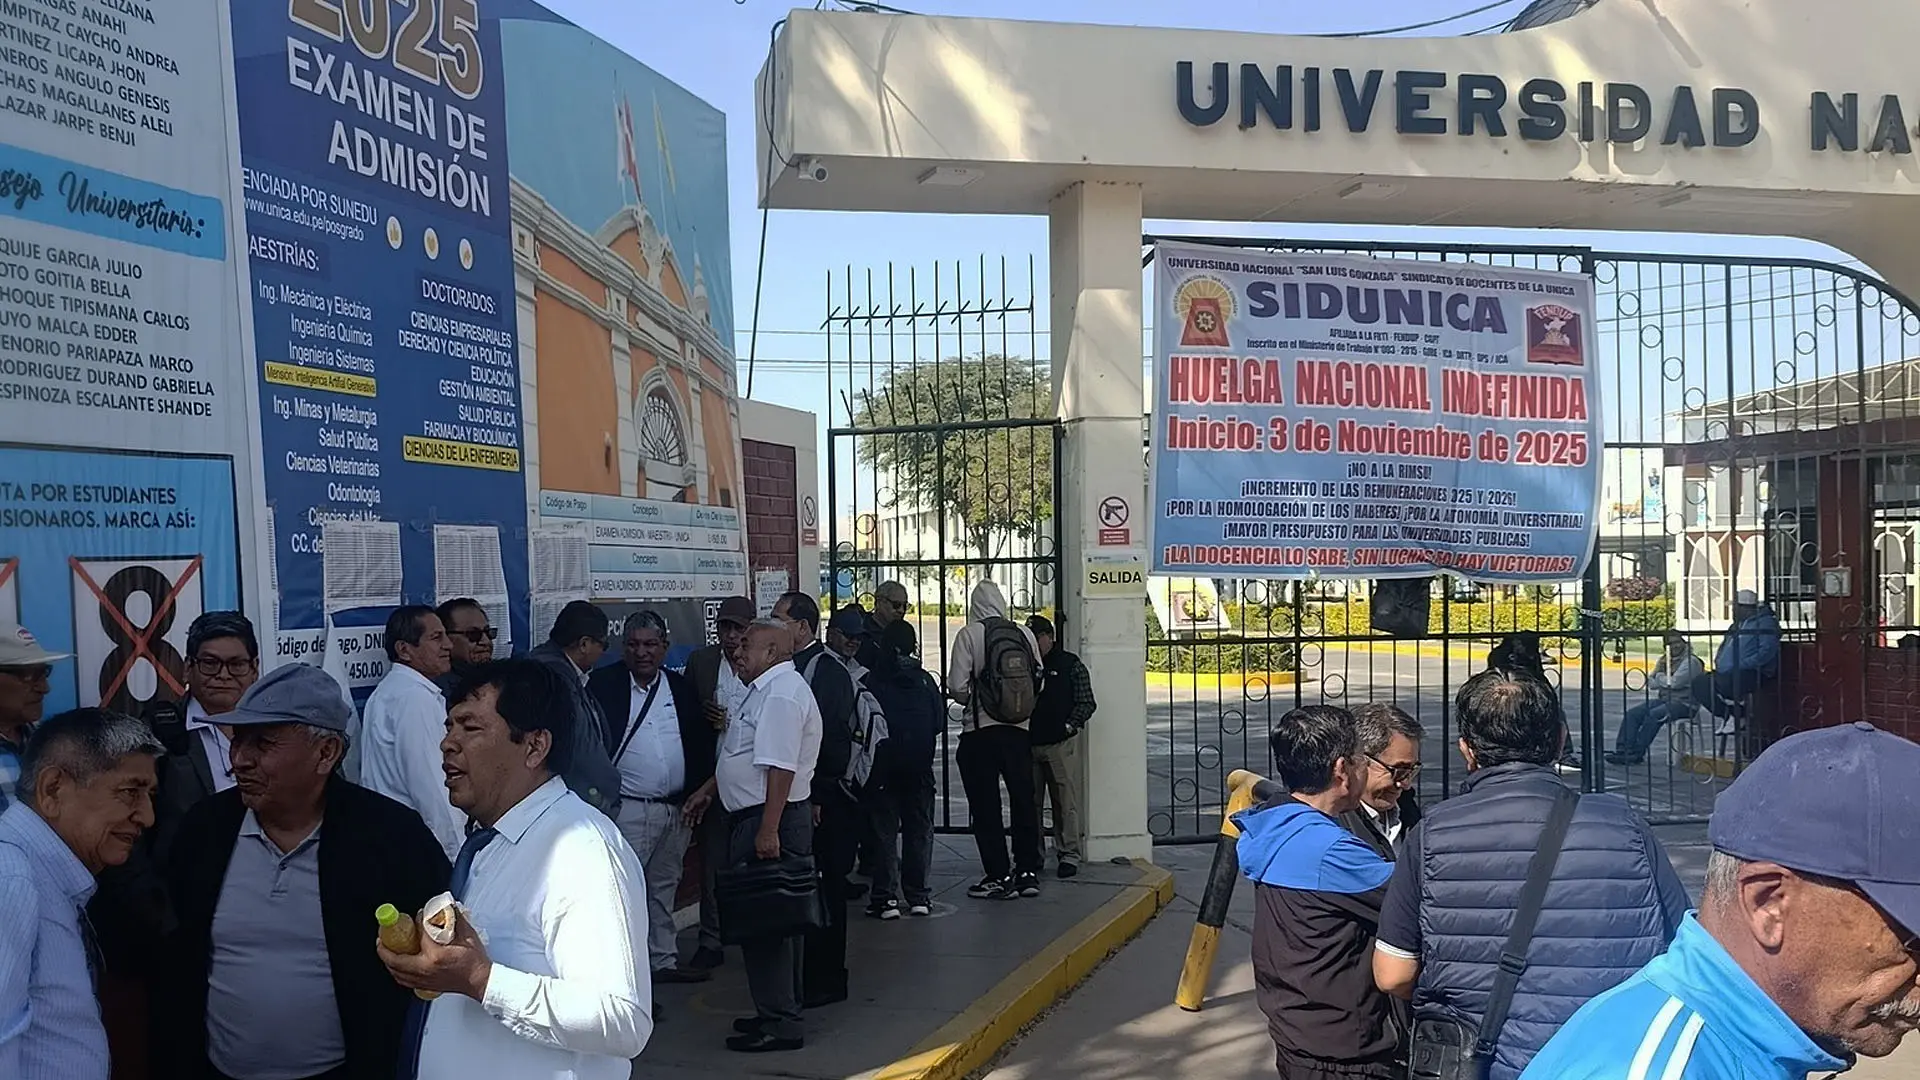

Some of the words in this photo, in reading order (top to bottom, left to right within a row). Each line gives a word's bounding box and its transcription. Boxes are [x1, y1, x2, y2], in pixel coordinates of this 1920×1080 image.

[82, 6, 126, 35] ANAHI
[57, 41, 106, 72] LICAPA
[110, 60, 146, 85] JHON
[66, 23, 121, 54] CAYCHO
[126, 45, 180, 76] ANDREA
[54, 64, 113, 95] ANGULO
[118, 85, 170, 114] GENESIS
[287, 36, 437, 140] EXAMEN
[446, 104, 488, 160] DE
[42, 82, 136, 124] MAGALLANES
[140, 114, 173, 136] ALELI
[1175, 60, 1760, 149] UNIVERSIDAD
[1810, 91, 1920, 154] NA
[52, 109, 94, 135] JARPE
[100, 123, 136, 146] BENJI
[328, 120, 490, 216] ADMISIÓN
[59, 171, 205, 238] Universitario:
[301, 185, 328, 211] POR
[330, 194, 378, 226] SUNEDU
[46, 247, 101, 272] GARCIA
[106, 258, 142, 280] JULIO
[1168, 257, 1240, 272] UNIVERSIDAD
[1242, 264, 1294, 276] NACIONAL
[1326, 266, 1348, 277] LUIS
[1401, 272, 1453, 286] SINDICATO
[1466, 278, 1516, 291] DOCENTES
[1519, 281, 1530, 292] DE
[1532, 283, 1543, 293] LA
[1546, 284, 1575, 296] UNICA
[35, 268, 86, 292] GOITIA
[91, 278, 131, 299] BELLA
[259, 279, 279, 304] Ing.
[280, 284, 325, 311] Mecánica
[422, 279, 496, 315] DOCTORADOS:
[60, 295, 138, 323] TIPISMANA
[143, 310, 190, 331] CARLOS
[1246, 281, 1507, 334] SIDUNICA
[38, 315, 89, 338] MALCA
[94, 323, 138, 345] EDDER
[411, 311, 449, 334] CIENCIAS
[450, 320, 512, 349] EMPRESARIALES
[1247, 338, 1278, 350] Inscrito
[0, 334, 61, 357] ENORIO
[66, 342, 144, 367] PARIAPAZA
[150, 354, 194, 374] MARCO
[335, 348, 375, 373] Sistemas
[398, 329, 440, 353] DERECHO
[440, 338, 448, 355] Y
[448, 339, 480, 361] CIENCIA
[480, 346, 514, 368] POLÍTICA
[87, 368, 147, 389] DURAND
[152, 376, 215, 397] GABRIELA
[471, 365, 515, 388] EDUCACIÓN
[1169, 356, 1283, 404] HUELGA
[1296, 359, 1431, 411] NACIONAL
[1442, 368, 1587, 420] INDEFINIDA
[76, 390, 154, 413] ESCALANTE
[158, 401, 212, 417] SHANDE
[273, 395, 292, 419] Ing.
[294, 397, 322, 419] Minas
[439, 379, 474, 400] GESTIÓN
[475, 386, 516, 407] AMBIENTAL
[424, 420, 466, 440] FARMACIA
[459, 404, 484, 423] SALUD
[485, 407, 517, 428] PÚBLICA
[319, 427, 345, 448] Salud
[405, 440, 445, 460] CIENCIAS
[446, 444, 458, 461] DE
[459, 445, 469, 461] LA
[1168, 415, 1263, 450] Inicio:
[1270, 417, 1288, 451] 3
[1296, 419, 1331, 452] de
[1338, 420, 1471, 460] Noviembre
[1479, 430, 1509, 462] de
[1516, 431, 1587, 465] 2025
[286, 451, 327, 473] Ciencias
[328, 454, 380, 477] Veterinarias
[1348, 462, 1366, 478] ¡NO
[1382, 464, 1394, 478] LA
[32, 483, 68, 502] POR
[73, 485, 177, 505] ESTUDIANTES
[1241, 480, 1316, 497] ¡INCREMENTO
[1321, 482, 1335, 497] DE
[1340, 483, 1360, 498] LAS
[1364, 484, 1447, 502] REMUNERACIONES
[105, 510, 160, 529] MARCA
[165, 508, 196, 529] ASÍ:
[1166, 500, 1194, 517] ¡POR
[1199, 501, 1212, 516] LA
[1217, 500, 1307, 518] HOMOLOGACIÓN
[1312, 503, 1325, 518] DE
[1330, 504, 1350, 519] LOS
[1354, 504, 1400, 520] HABERES!
[1403, 506, 1426, 522] ¡POR
[1429, 507, 1440, 522] LA
[1443, 508, 1499, 525] ATONOMÍA
[1503, 512, 1584, 529] UNIVERSITARIA!
[1223, 522, 1267, 539] ¡MAYOR
[1272, 524, 1347, 540] PRESUPUESTO
[1351, 525, 1378, 540] PARA
[1382, 526, 1398, 540] LAS
[1401, 526, 1472, 545] UNIVERSIDDES
[1476, 532, 1530, 548] PUBLICAS!
[1164, 546, 1190, 565] ¡LA
[1194, 546, 1283, 565] DOCENCIA
[1284, 548, 1305, 565] LO
[1308, 548, 1350, 567] SABE,
[1353, 548, 1379, 566] SIN
[1456, 552, 1487, 570] HAY
[1489, 555, 1575, 573] VICTORIAS!
[1089, 571, 1142, 585] SALIDA
[349, 661, 384, 679] 450.00
